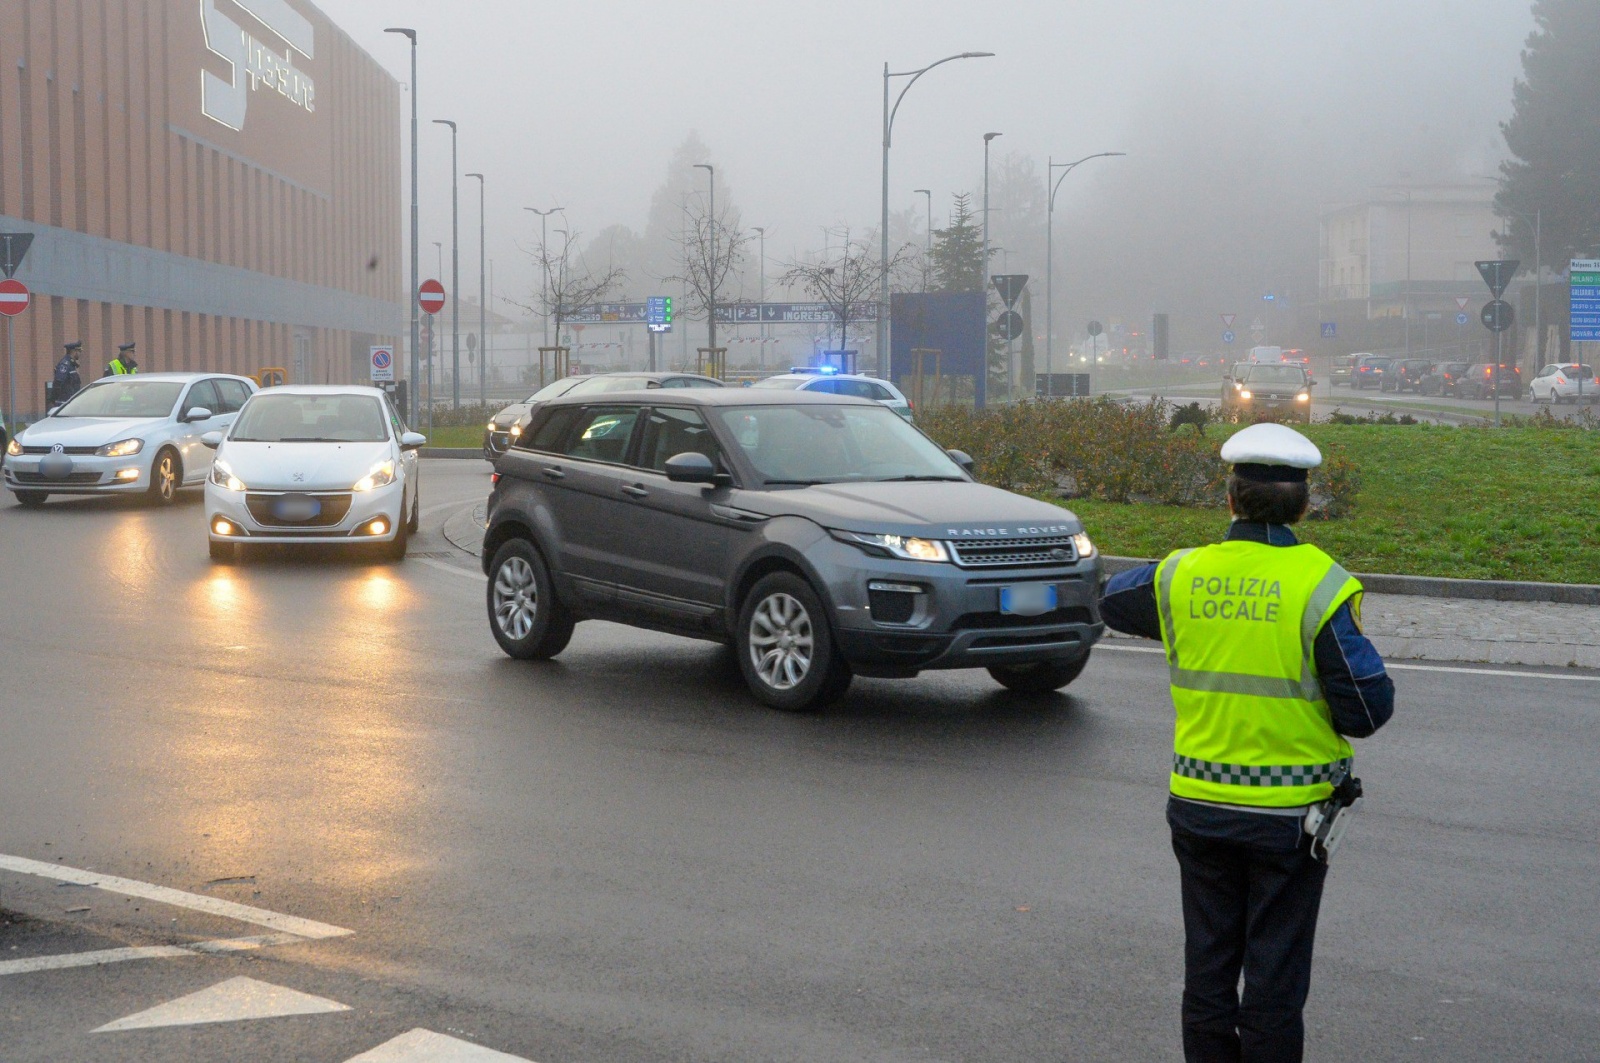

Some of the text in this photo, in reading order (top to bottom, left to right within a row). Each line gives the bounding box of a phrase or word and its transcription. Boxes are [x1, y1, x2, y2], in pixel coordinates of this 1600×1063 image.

[947, 525, 1068, 536] RANGE ROVER
[1191, 577, 1281, 599] POLIZIA
[1190, 600, 1280, 622] LOCALE
